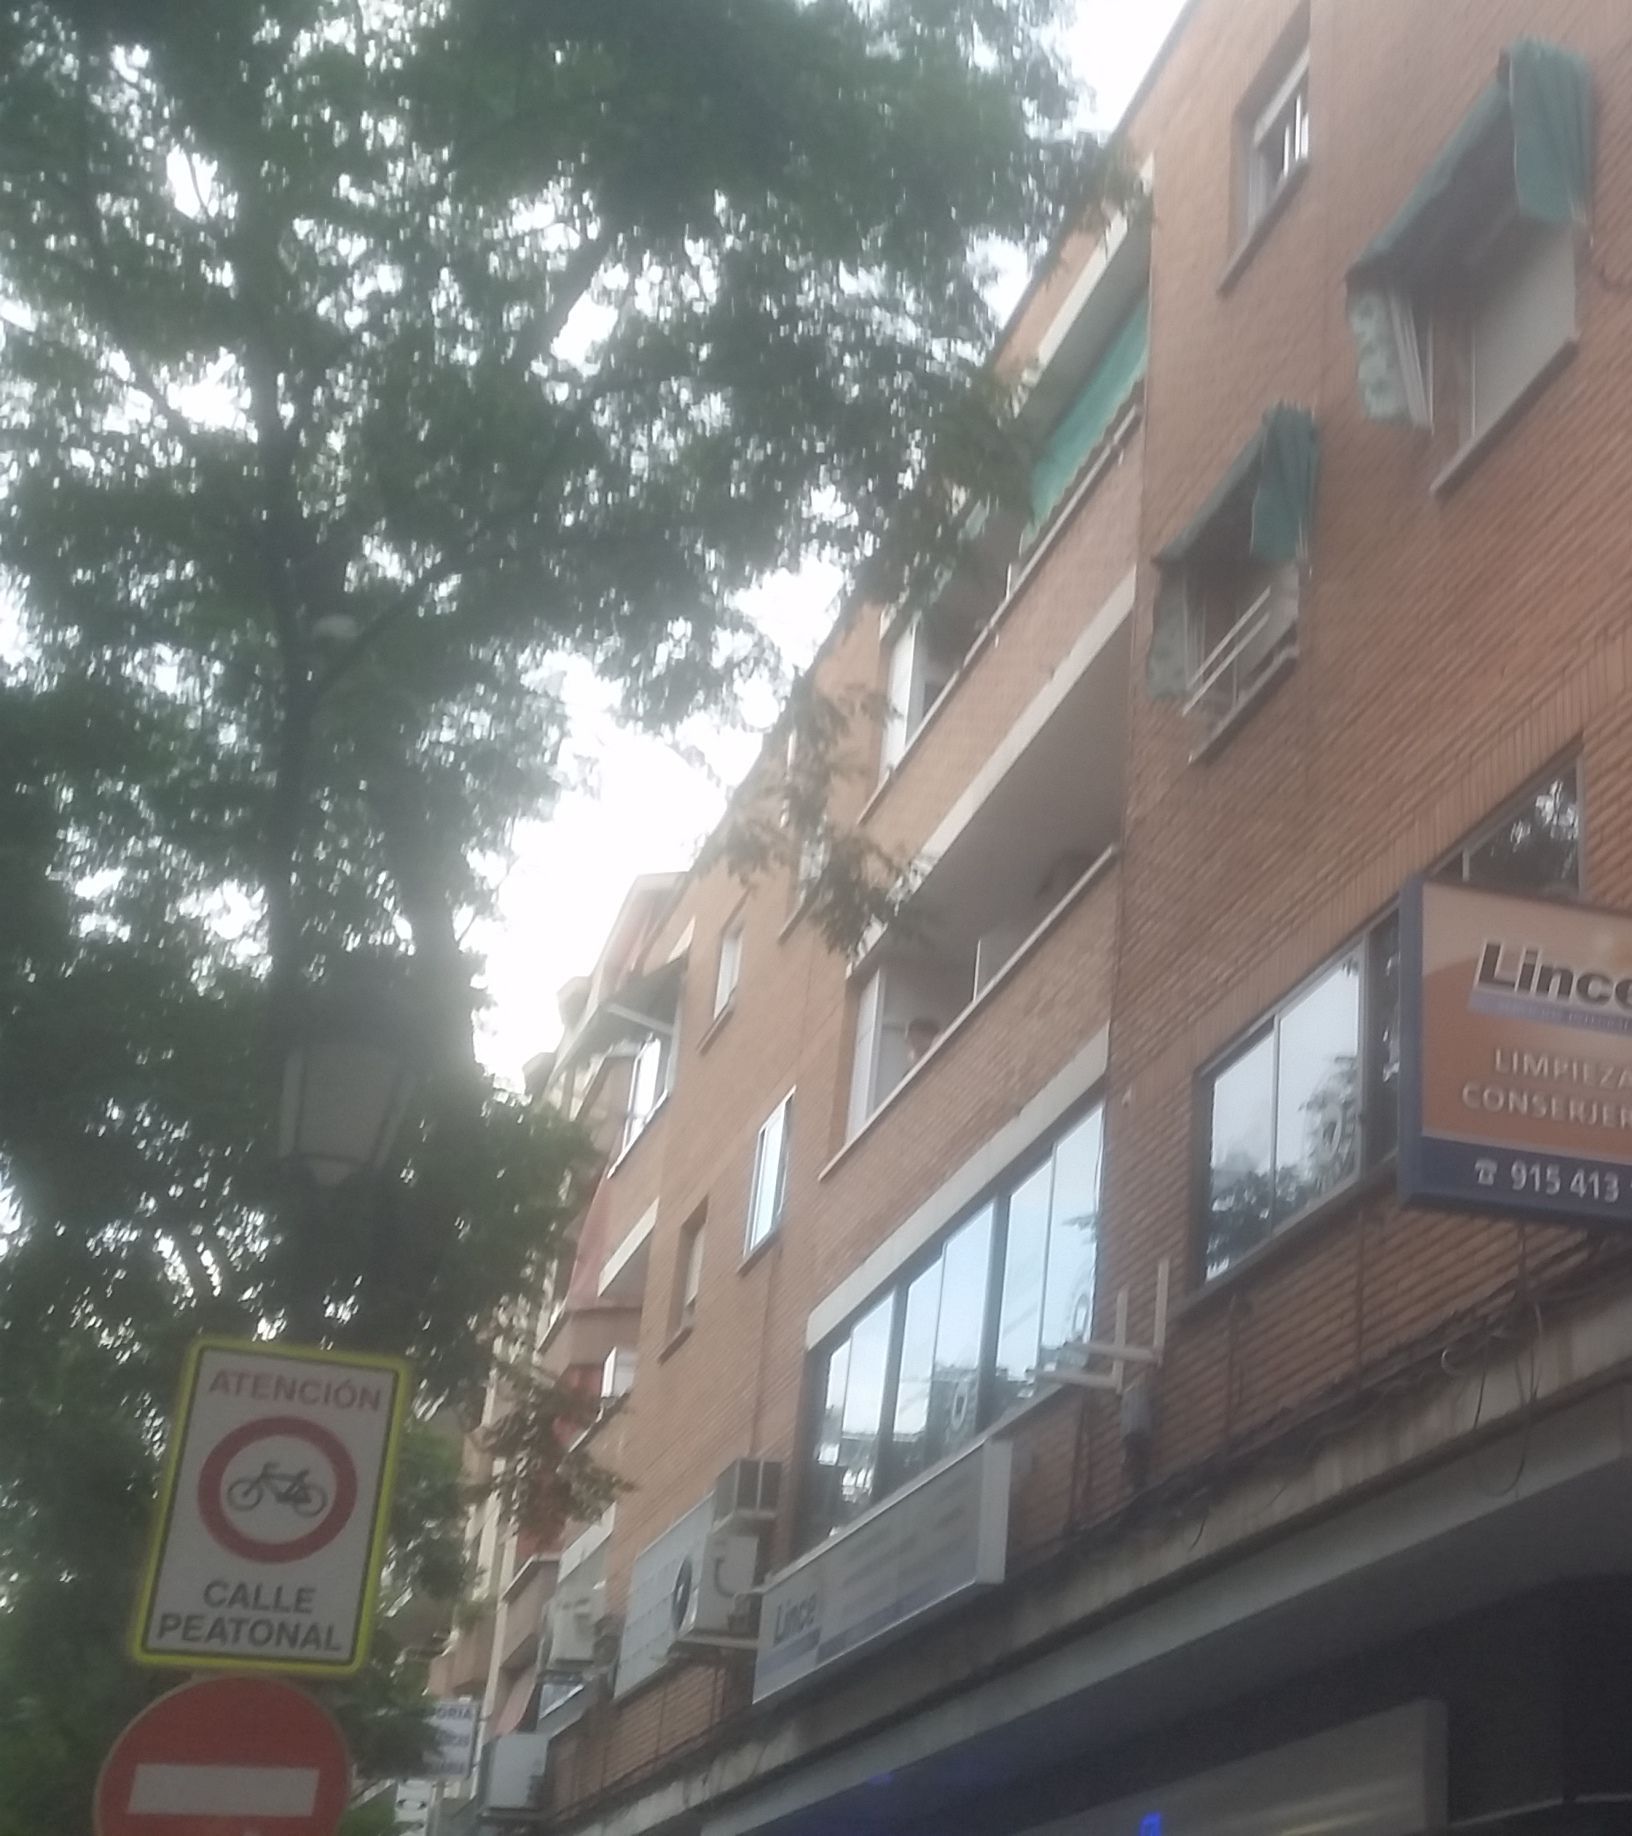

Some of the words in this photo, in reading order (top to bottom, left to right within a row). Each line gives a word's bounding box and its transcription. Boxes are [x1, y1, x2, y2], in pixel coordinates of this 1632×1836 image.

[1510, 1161, 1561, 1197] 915
[1569, 1169, 1620, 1204] 413
[209, 1369, 381, 1412] ATENCIÓN
[202, 1578, 317, 1615] CALLE
[156, 1613, 343, 1653] PEATONAL
